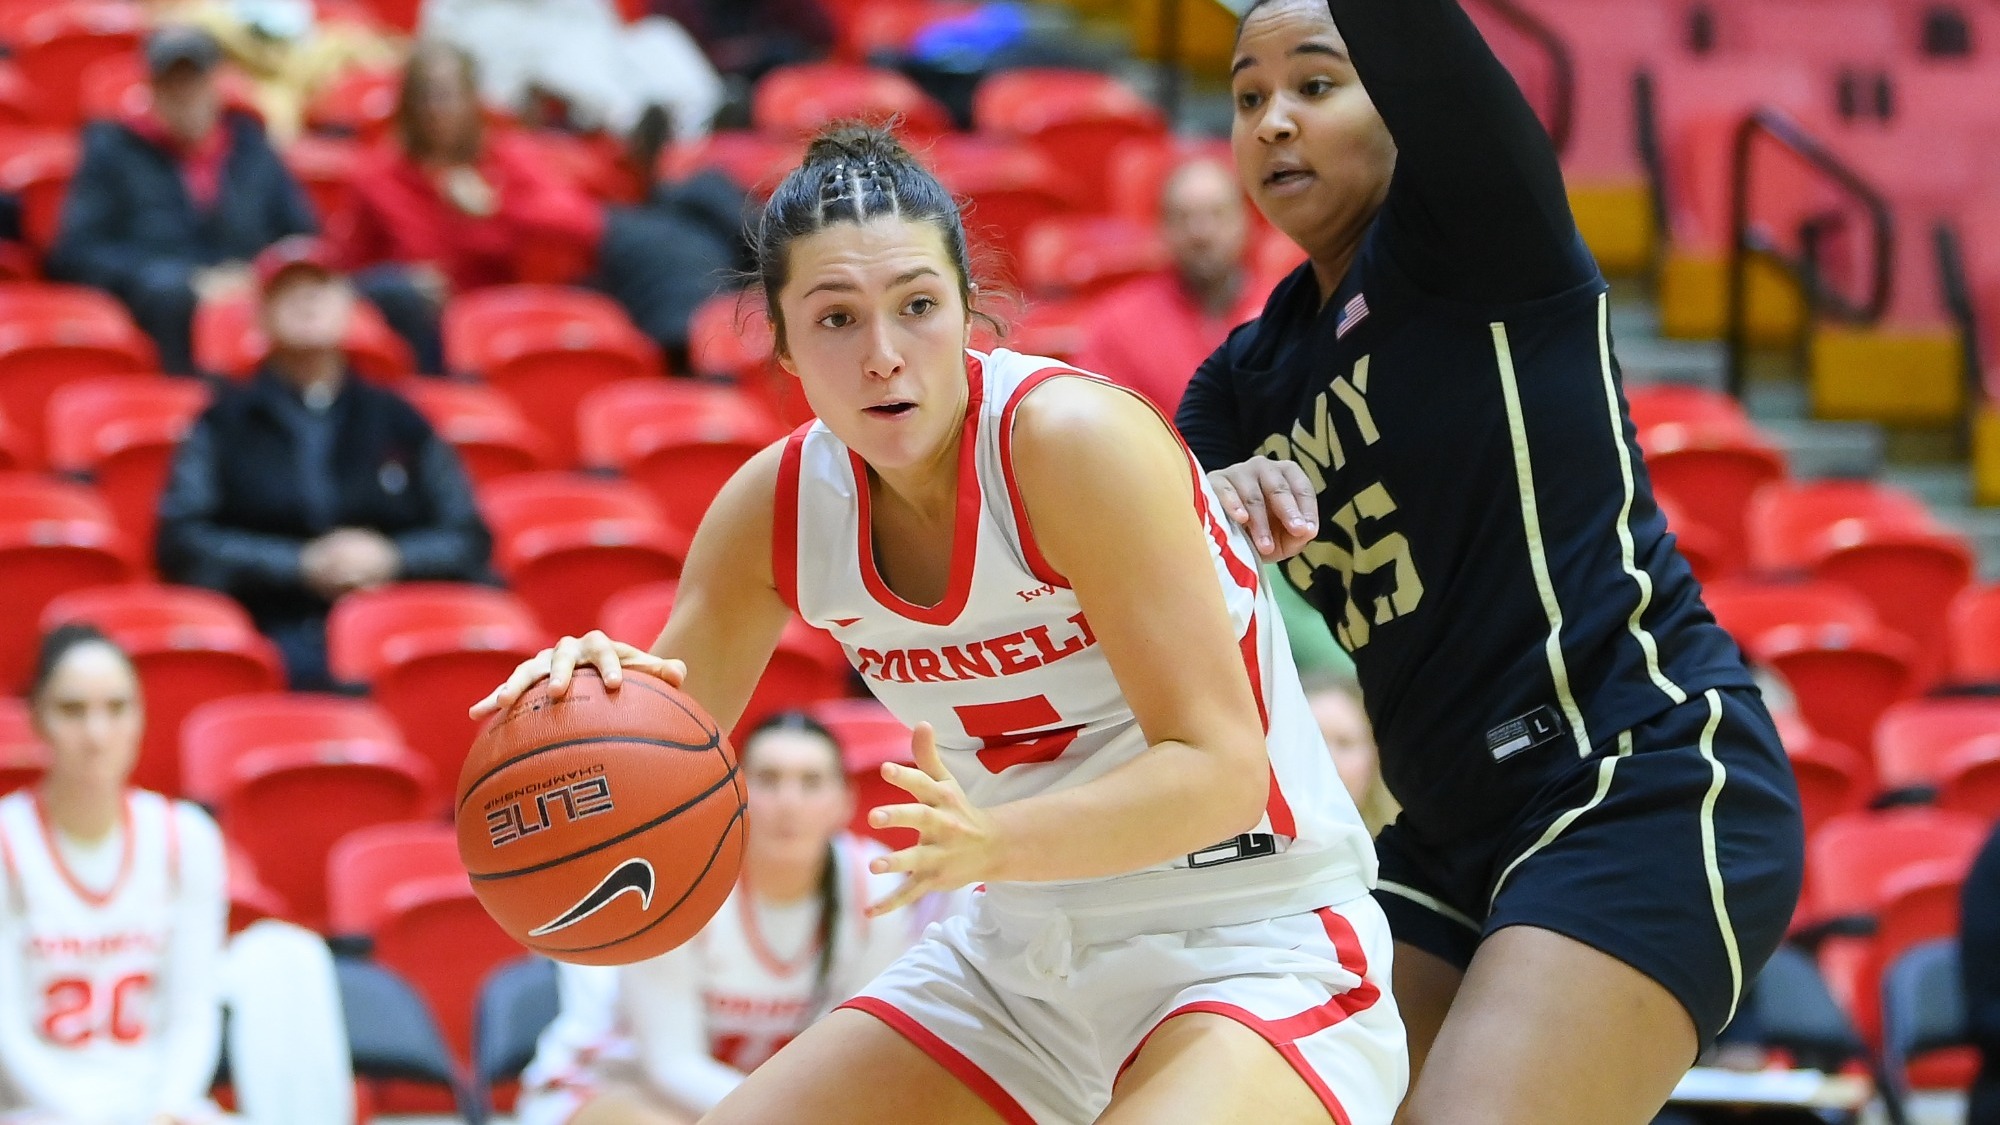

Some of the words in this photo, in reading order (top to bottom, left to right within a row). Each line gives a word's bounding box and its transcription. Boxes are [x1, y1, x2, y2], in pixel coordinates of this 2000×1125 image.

[1254, 354, 1380, 494] MY
[1016, 584, 1056, 603] Ivy
[953, 694, 1086, 774] 5
[1533, 718, 1550, 734] L
[484, 764, 604, 810] CHAMPIONSHIP
[486, 774, 615, 849] ELITE
[1248, 832, 1261, 848] L
